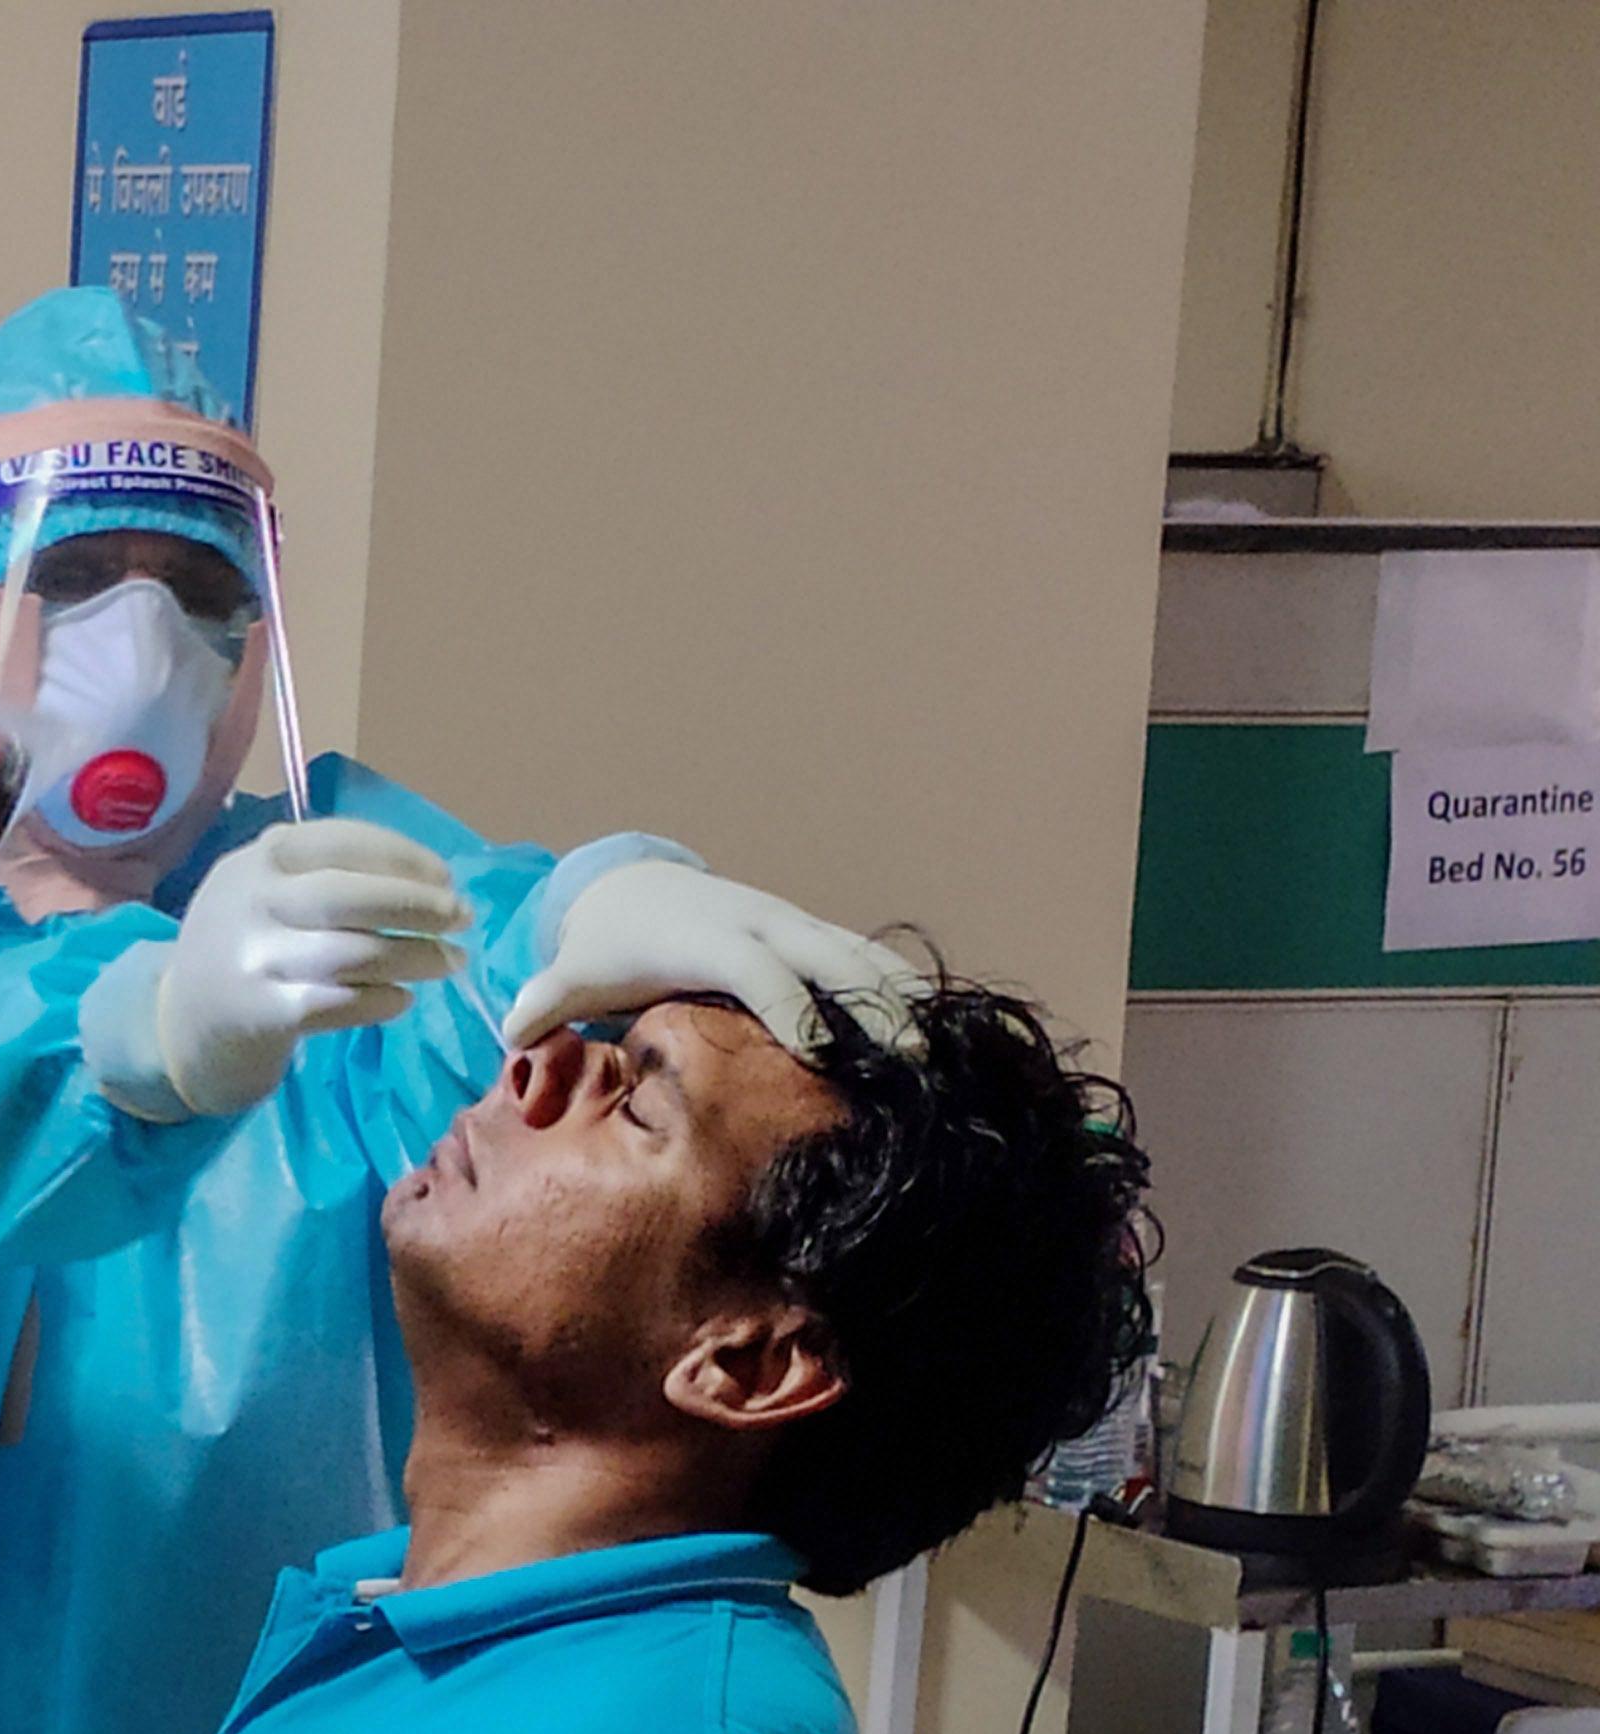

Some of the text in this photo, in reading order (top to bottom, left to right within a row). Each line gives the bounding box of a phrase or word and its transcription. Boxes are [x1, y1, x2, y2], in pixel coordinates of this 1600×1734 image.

[107, 440, 186, 469] FACE
[1428, 785, 1594, 823] Quarantine
[1429, 848, 1587, 884] Bed No. 56
